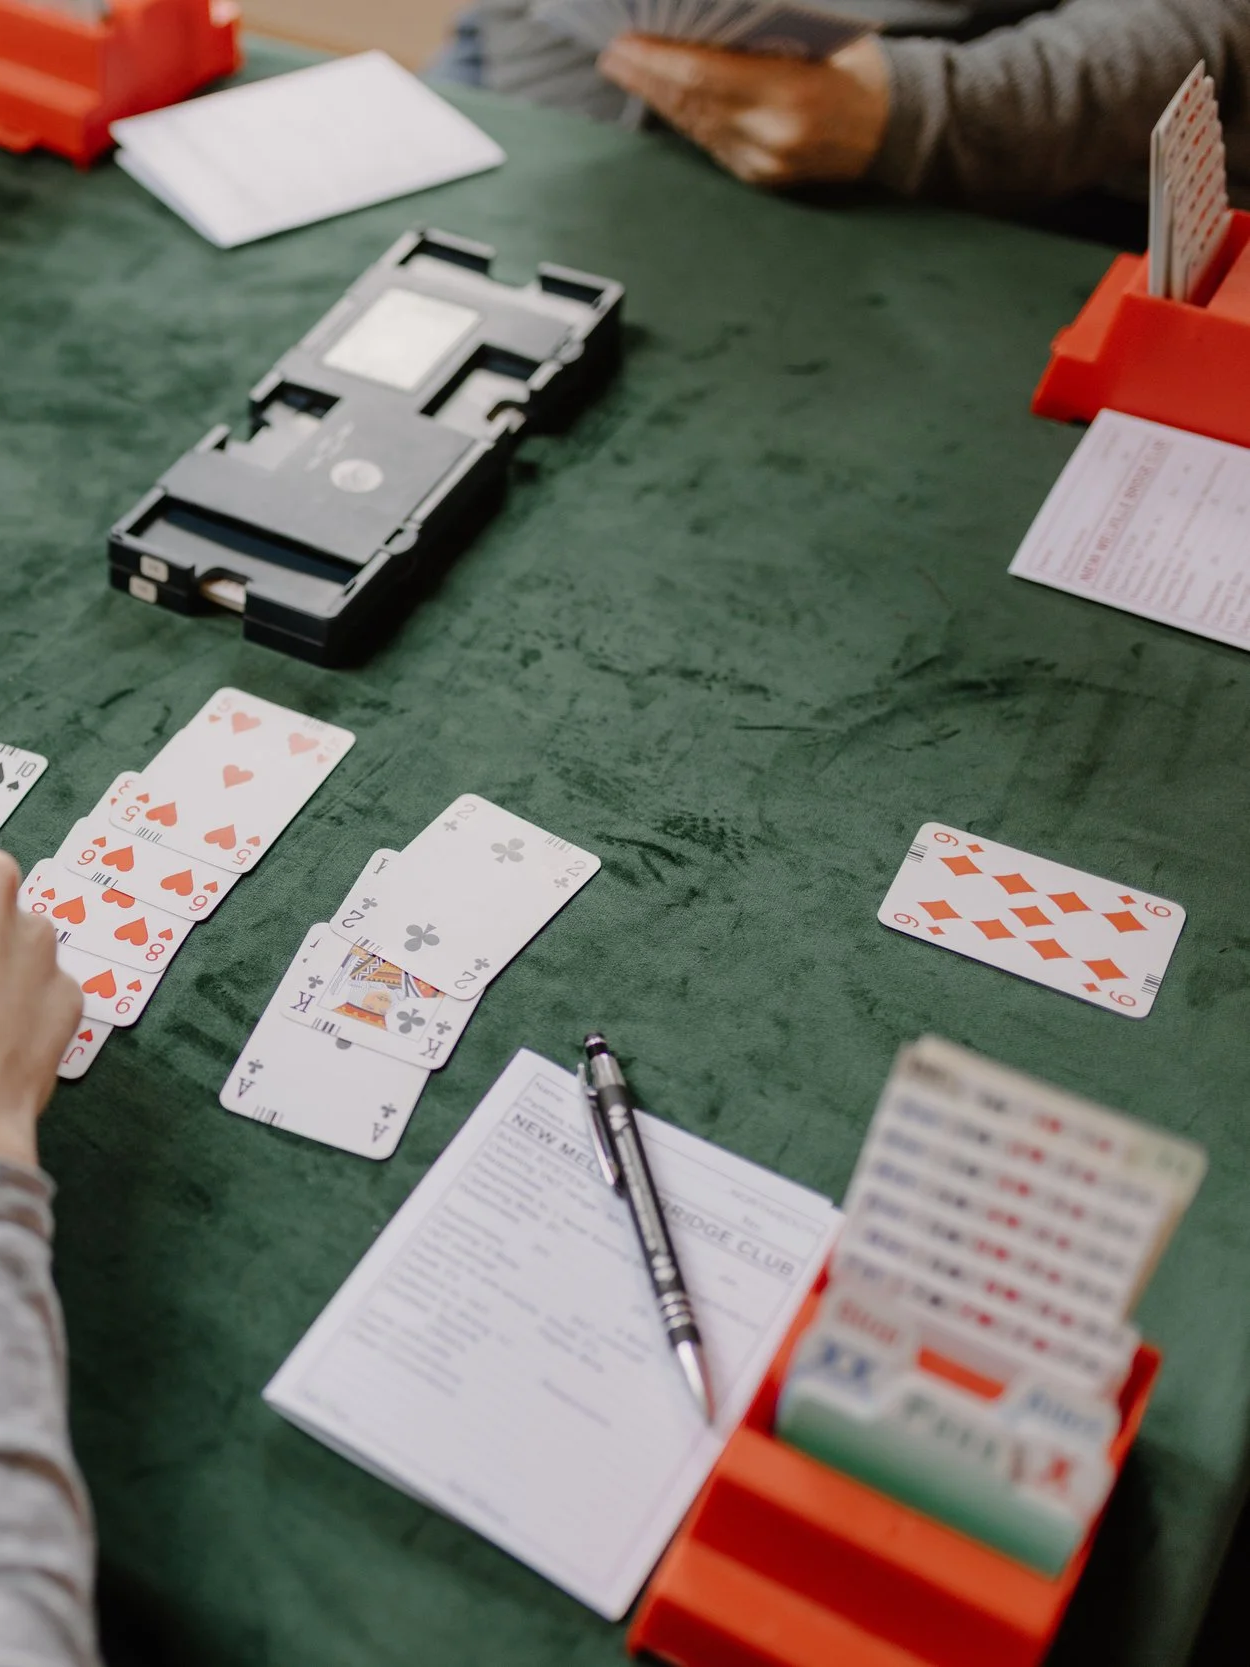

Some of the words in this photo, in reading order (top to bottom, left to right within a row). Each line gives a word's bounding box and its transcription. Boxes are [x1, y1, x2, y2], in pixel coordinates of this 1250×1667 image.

[15, 760, 37, 778] 10
[121, 805, 141, 822] 5
[232, 848, 252, 866] 5
[565, 860, 587, 878] 2
[341, 909, 365, 929] 2
[145, 943, 165, 961] 8
[454, 970, 478, 990] 2
[291, 991, 316, 1014] K
[62, 1046, 85, 1065] J
[419, 1037, 444, 1060] K
[237, 1077, 255, 1099] A
[372, 1122, 390, 1144] A
[512, 1113, 557, 1145] NEW
[736, 1240, 795, 1276] CLUB
